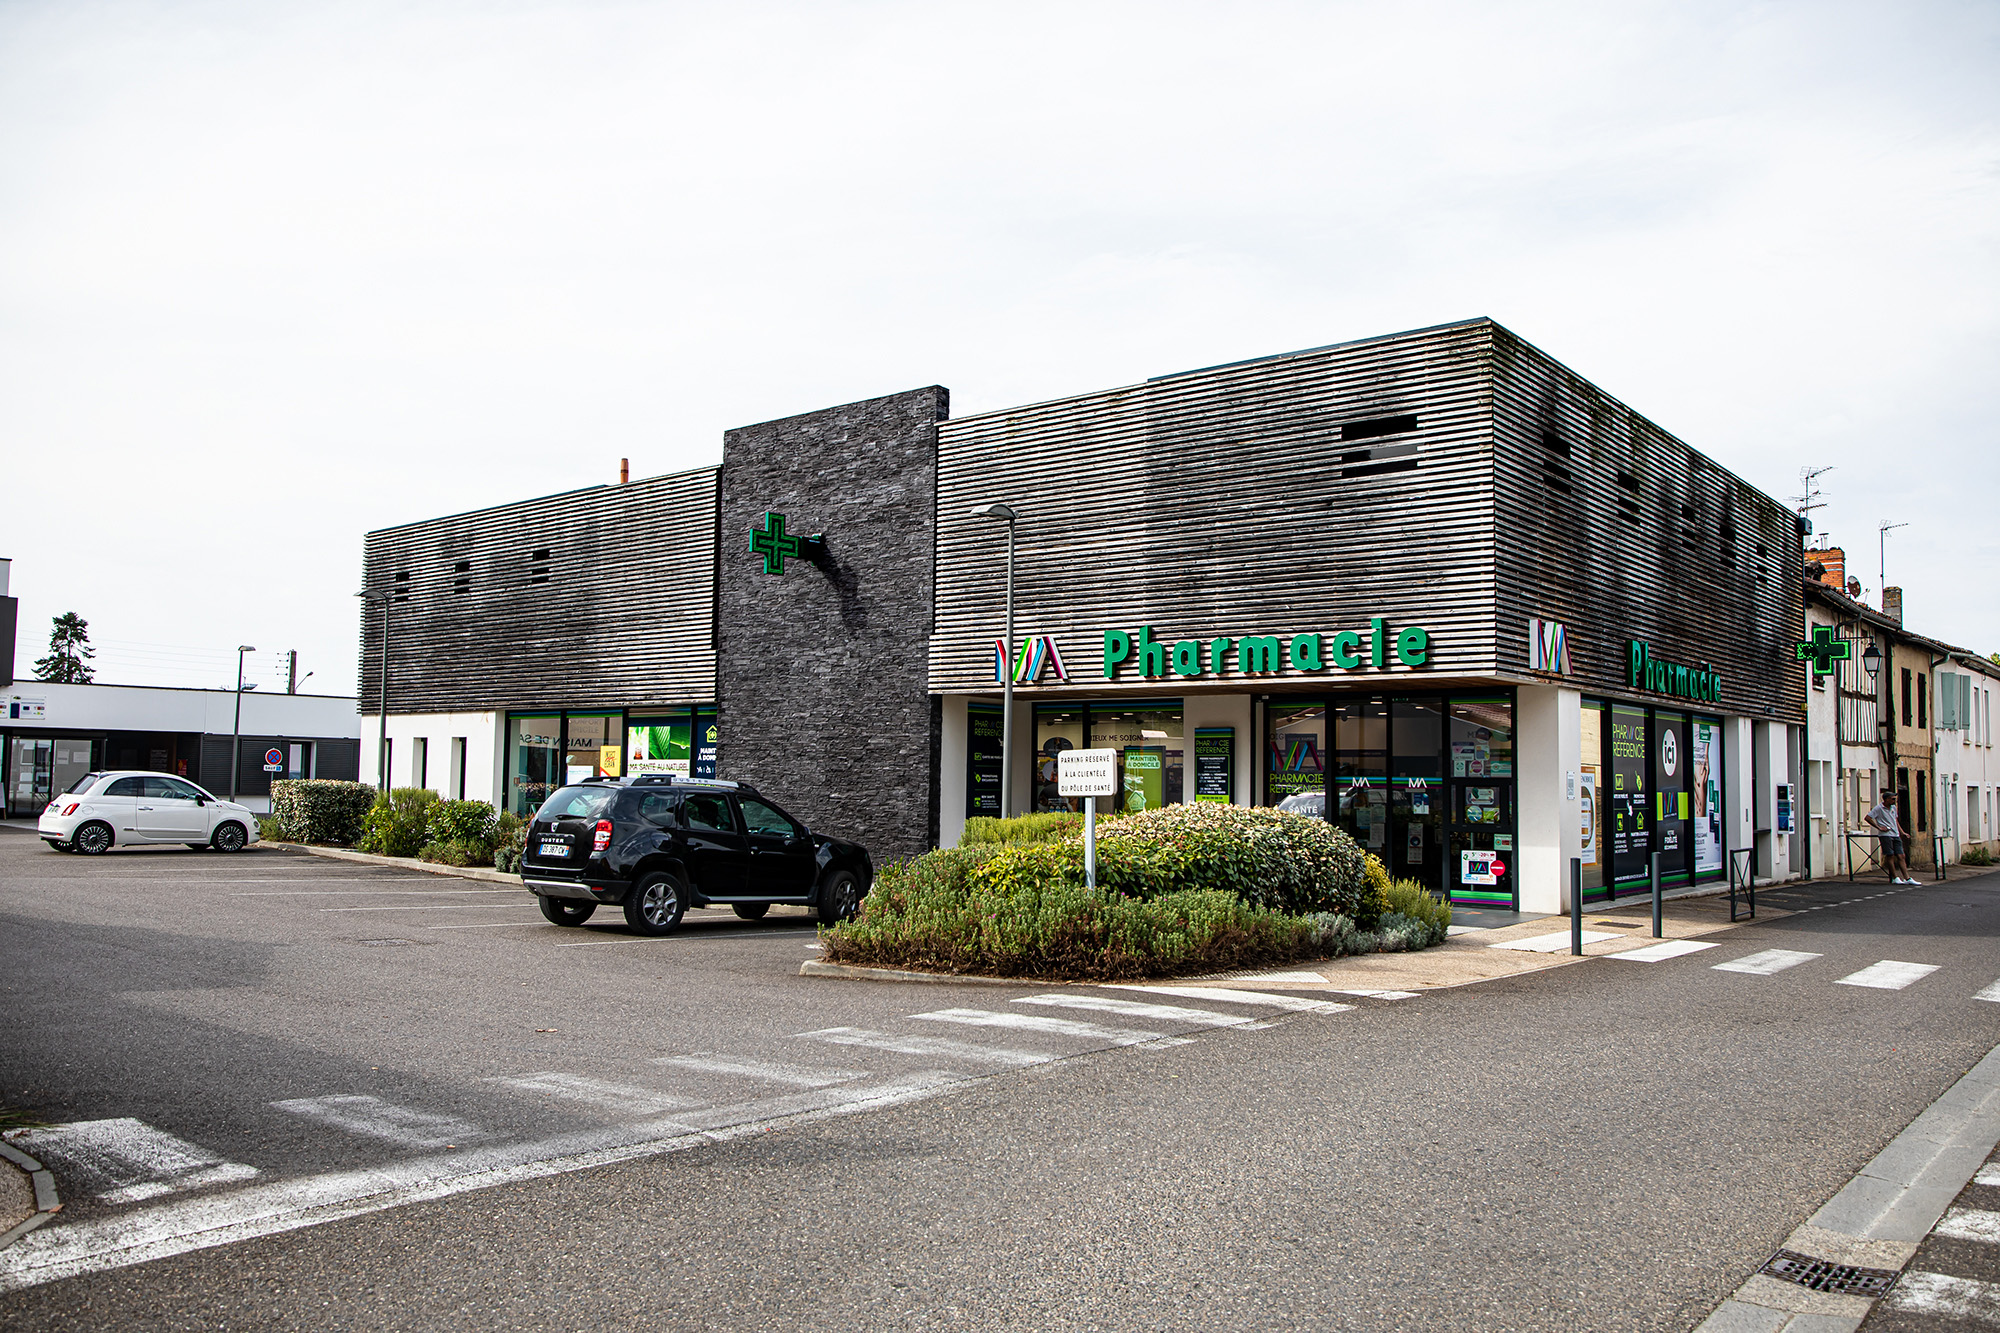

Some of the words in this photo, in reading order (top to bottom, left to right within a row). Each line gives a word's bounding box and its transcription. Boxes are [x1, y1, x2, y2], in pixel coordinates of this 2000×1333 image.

[1103, 617, 1429, 679] Pharmacie
[1627, 640, 1722, 703] Pharmacie
[1664, 740, 1675, 765] ici
[1085, 755, 1110, 763] RÉSERVÉ
[1269, 773, 1324, 783] PHARMACIE
[1070, 783, 1083, 792] PÔLE
[1094, 783, 1111, 791] SANTÉ
[1288, 804, 1318, 814] SANTÉ
